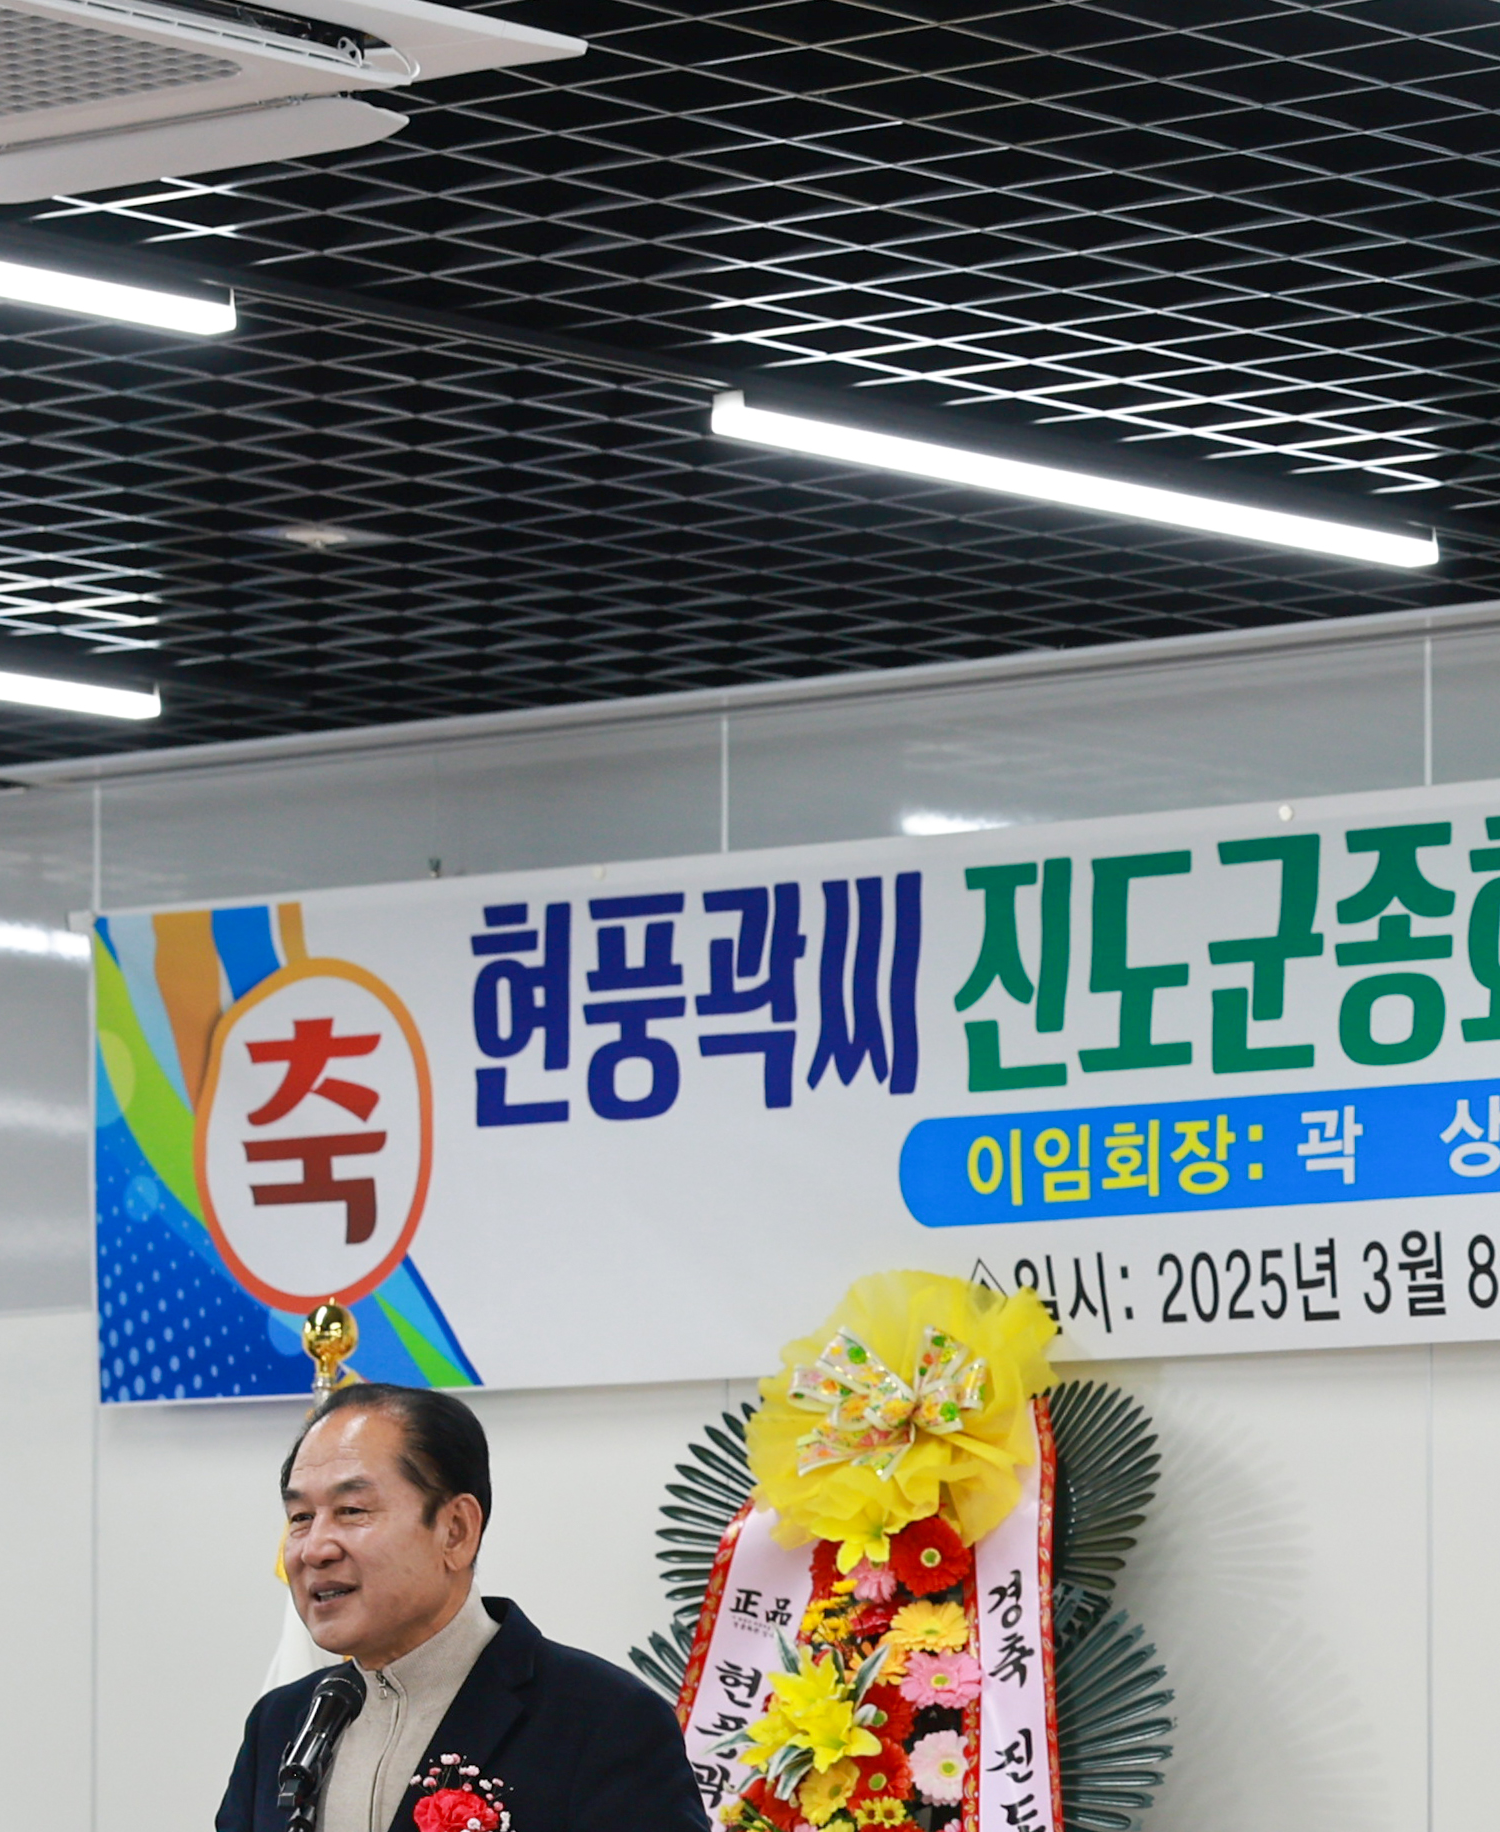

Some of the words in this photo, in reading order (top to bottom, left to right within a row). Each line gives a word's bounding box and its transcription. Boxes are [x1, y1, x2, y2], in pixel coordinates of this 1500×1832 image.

[470, 871, 921, 1127] 현풍곽씨
[242, 1017, 387, 1244] 축
[966, 1113, 1265, 1205] 이임회장:
[1158, 1236, 1340, 1324] 2025년
[1362, 1229, 1447, 1306] 3월
[987, 1570, 1034, 1687] 경축
